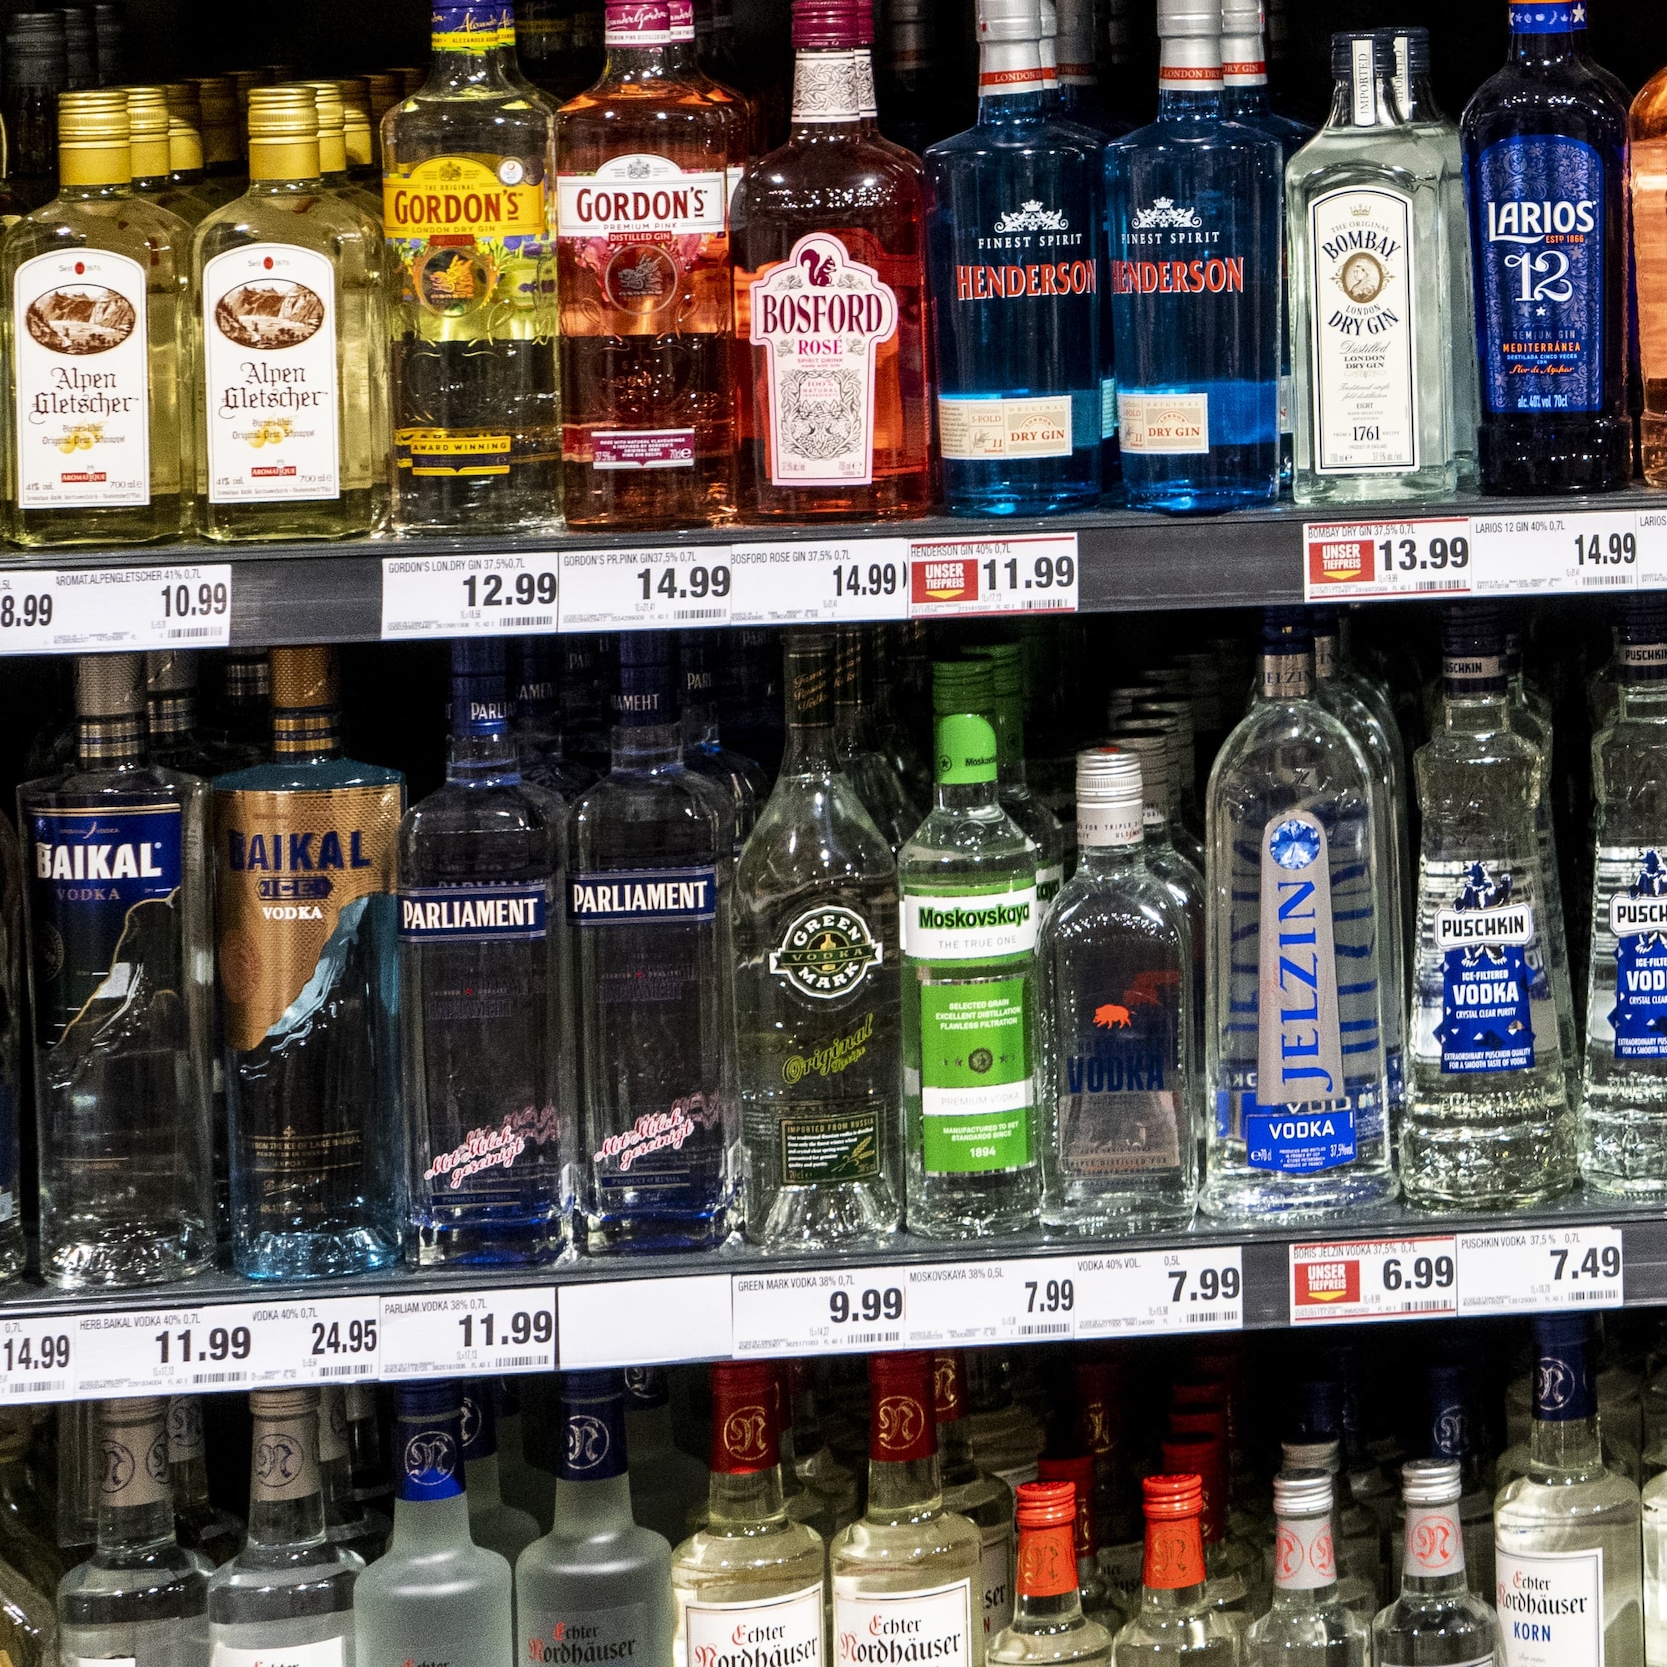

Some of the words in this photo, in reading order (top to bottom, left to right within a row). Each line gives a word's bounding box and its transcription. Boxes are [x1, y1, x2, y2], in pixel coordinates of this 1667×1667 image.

[395, 189, 518, 224] GORDON'S
[577, 188, 704, 223] GORDON'S
[1489, 202, 1593, 242] LARIOS
[978, 236, 1032, 249] FINEST
[1039, 233, 1082, 246] SPIRIT
[1323, 228, 1400, 263] BOMBAY
[957, 258, 1097, 301] HENDERSON
[1504, 250, 1572, 303] 12
[762, 293, 883, 335] BOSFORD
[798, 338, 842, 355] ROSÉ
[241, 362, 305, 387] Alpen
[911, 546, 958, 557] HENDERSON
[960, 545, 974, 555] GIN
[976, 544, 992, 553] 40%
[1379, 539, 1469, 570] 13.99
[1575, 533, 1636, 565] 14.99
[834, 563, 896, 595] 14.99
[925, 562, 964, 578] UNSER
[926, 578, 964, 589] TIEFPREIS
[983, 556, 1075, 590] 11.99
[161, 584, 226, 616] 10.99
[463, 573, 557, 608] 12.99
[36, 839, 161, 879] BAIKAL
[262, 905, 322, 919] VODKA
[573, 881, 708, 912] PARLIAMENT
[919, 902, 1031, 931] Moskovskaya
[1280, 880, 1334, 1093] JELZIN
[1453, 981, 1519, 1005] VODKA
[1269, 1122, 1335, 1139] VODKA
[1382, 1257, 1454, 1290] 6.99
[1550, 1248, 1620, 1282] 7.49
[829, 1287, 902, 1323] 9.99
[1025, 1280, 1073, 1313] 7.99
[155, 1326, 251, 1362] 11.99
[312, 1320, 376, 1356] 24.95
[459, 1310, 553, 1346] 11.99
